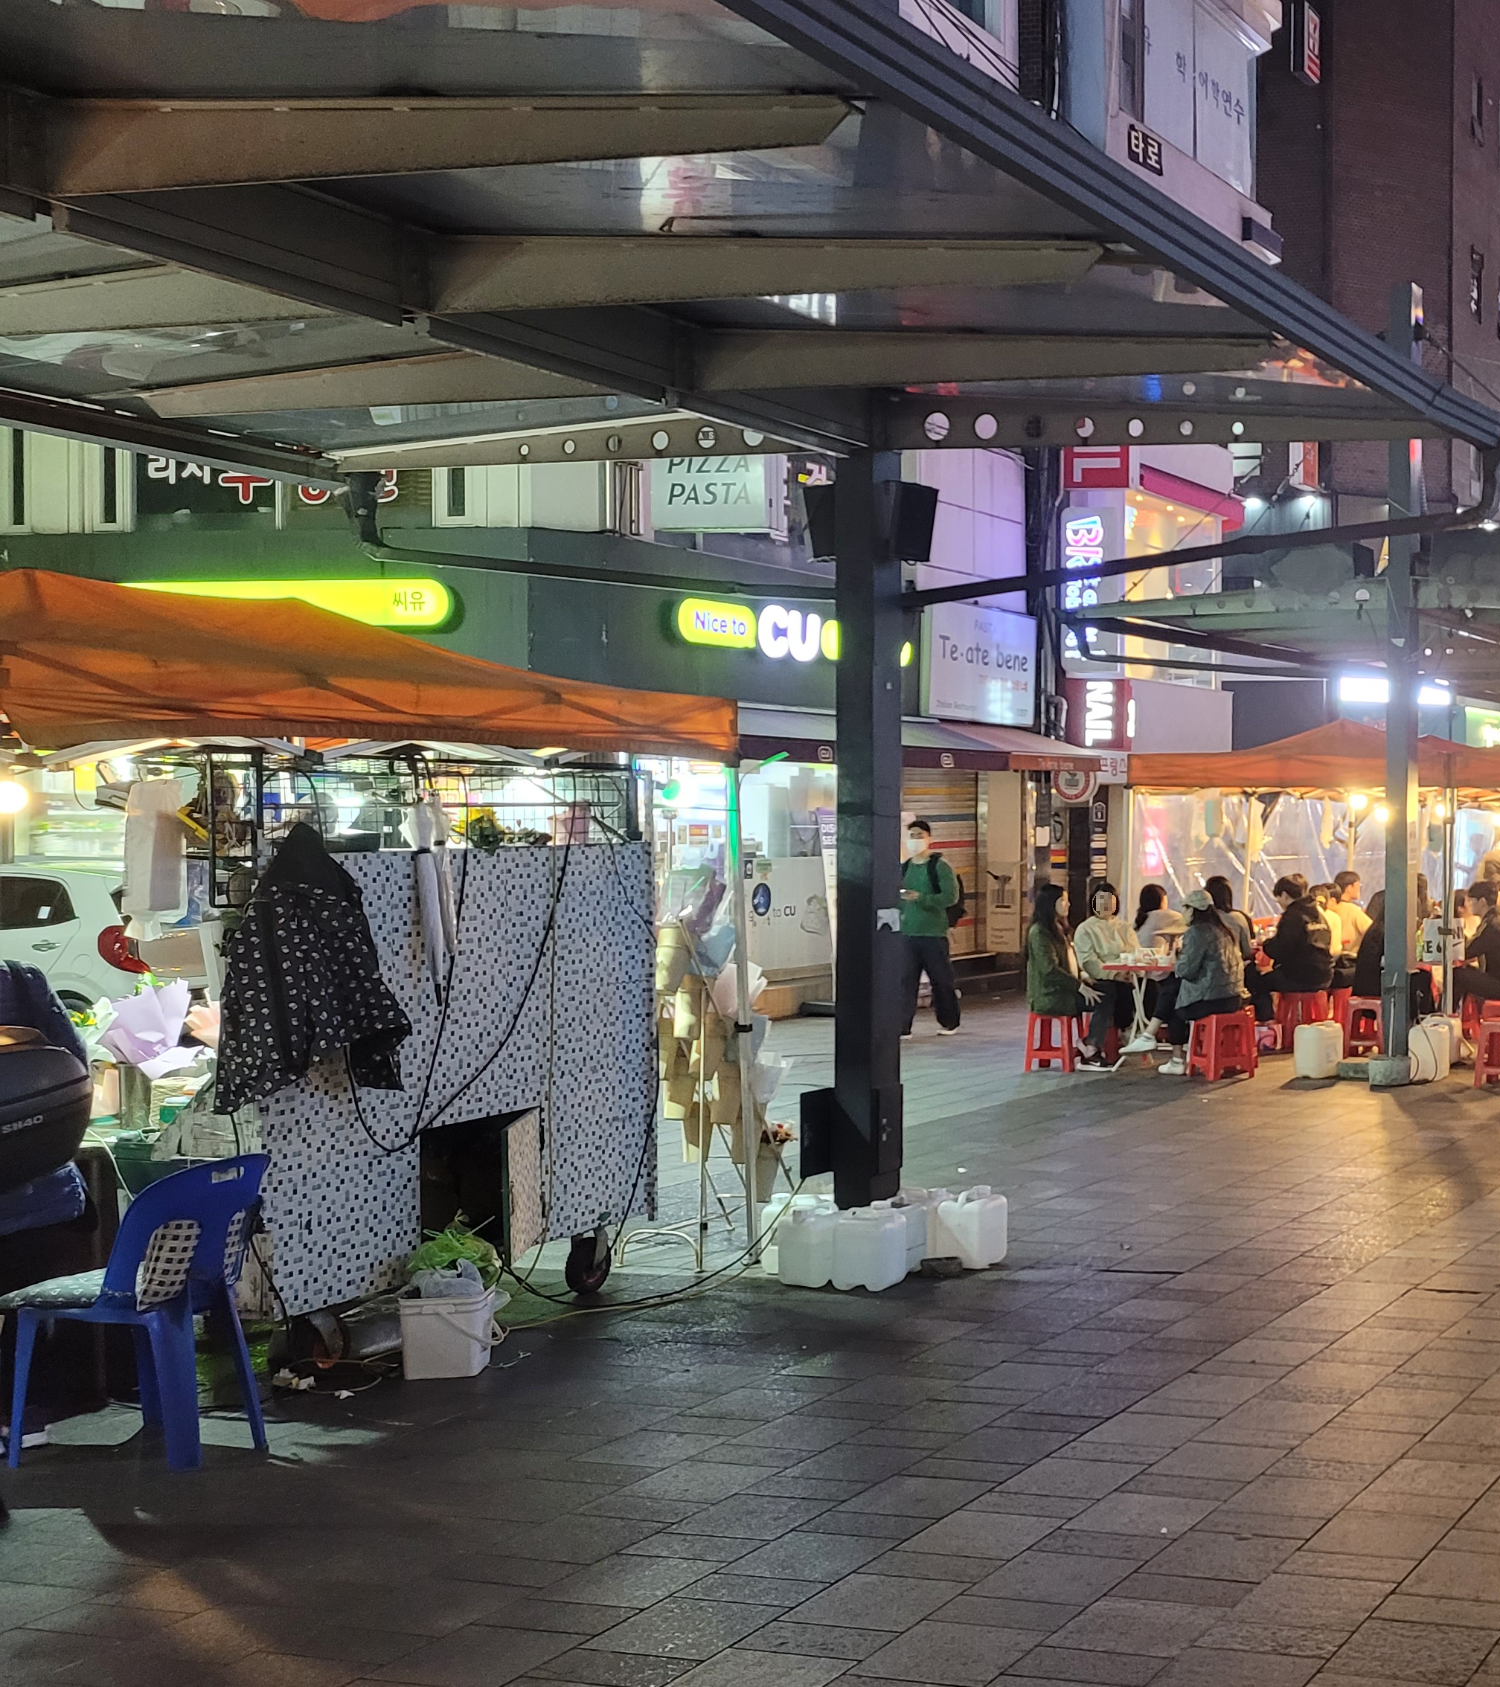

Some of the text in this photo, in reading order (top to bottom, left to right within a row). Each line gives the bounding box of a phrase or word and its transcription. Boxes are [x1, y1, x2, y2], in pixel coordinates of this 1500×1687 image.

[1131, 129, 1162, 169] 타로
[667, 482, 752, 506] PASTA
[392, 591, 426, 612] 씨유
[695, 604, 821, 662] Nice to CU
[995, 643, 1028, 672] bene
[1084, 681, 1114, 747] NAIL
[783, 904, 796, 917] CU
[1, 1114, 44, 1134] SH40
